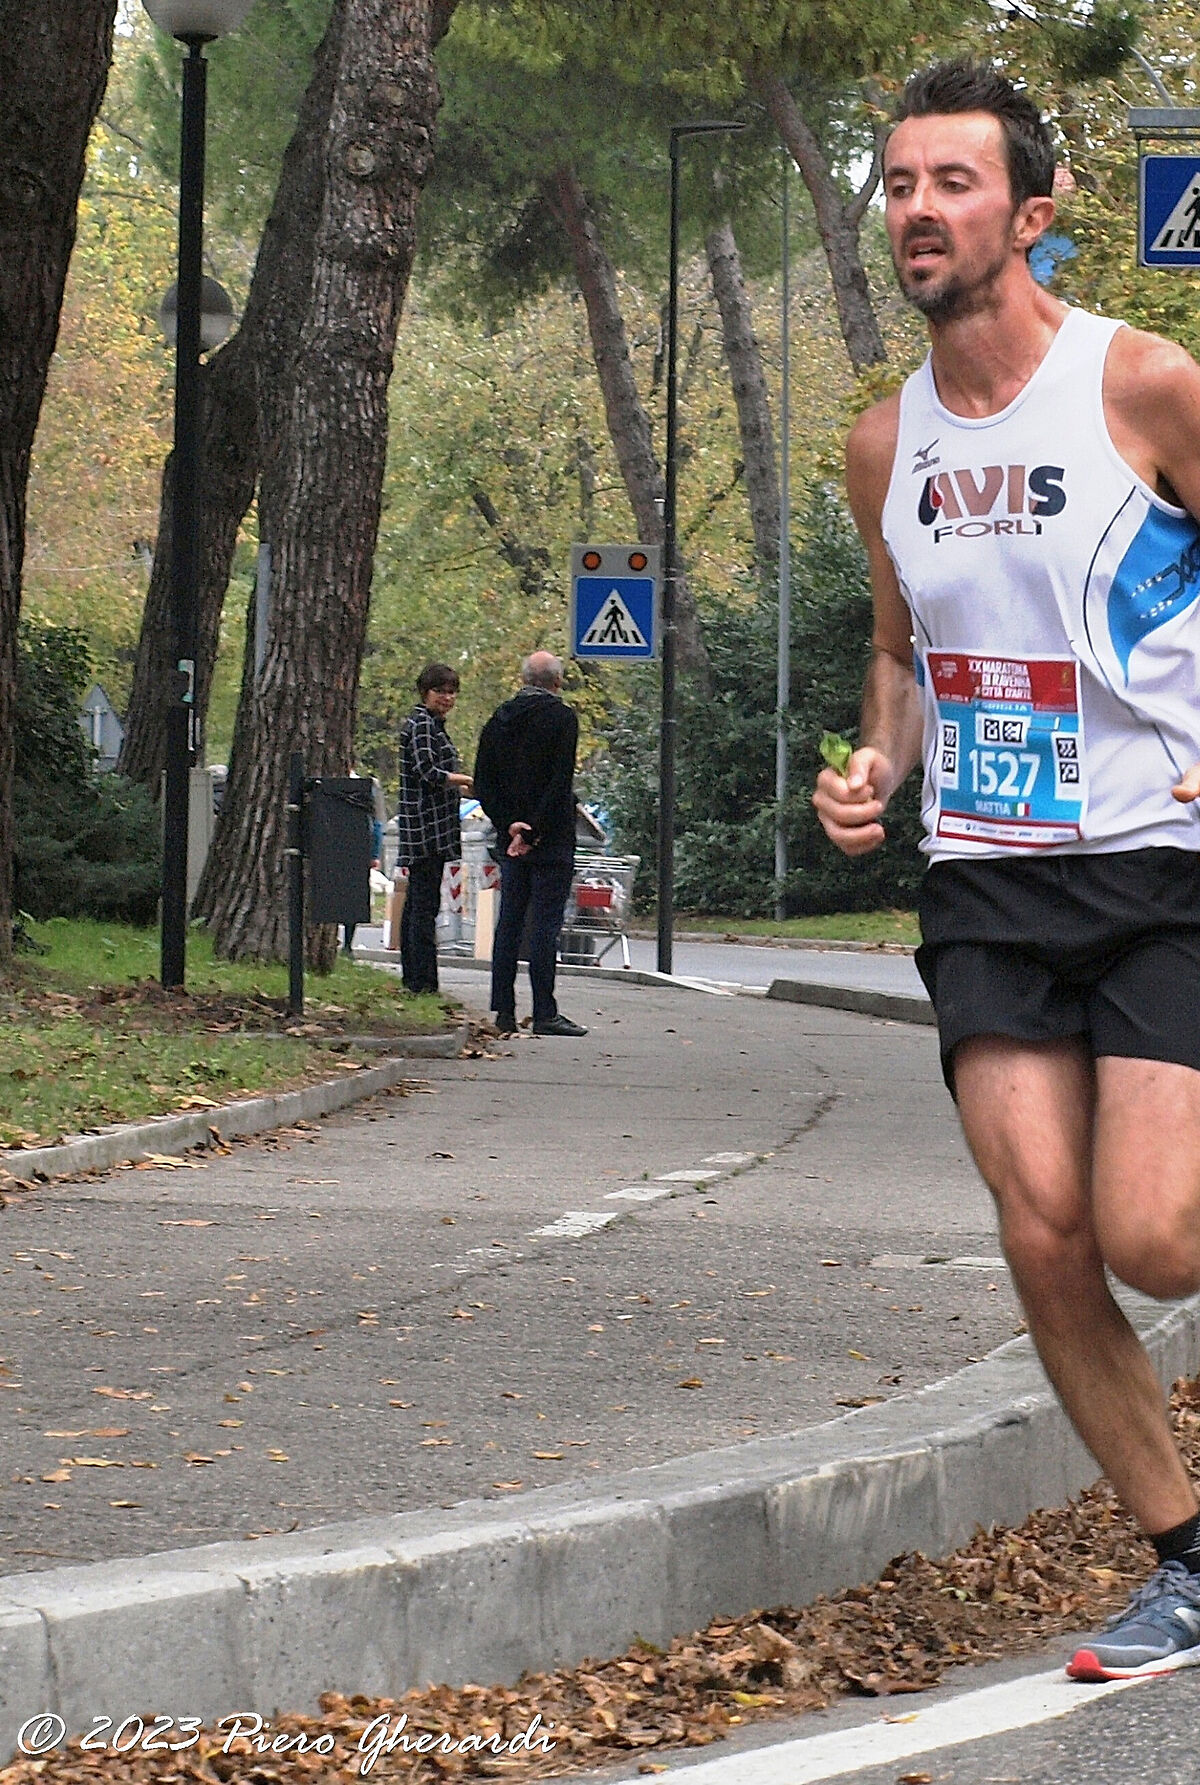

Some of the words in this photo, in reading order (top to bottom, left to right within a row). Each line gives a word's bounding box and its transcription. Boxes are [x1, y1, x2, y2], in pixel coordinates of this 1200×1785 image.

[918, 464, 1067, 526] AVIS
[982, 660, 1028, 676] MARATONA
[969, 749, 1040, 797] 1527
[975, 800, 1011, 817] MATTIA
